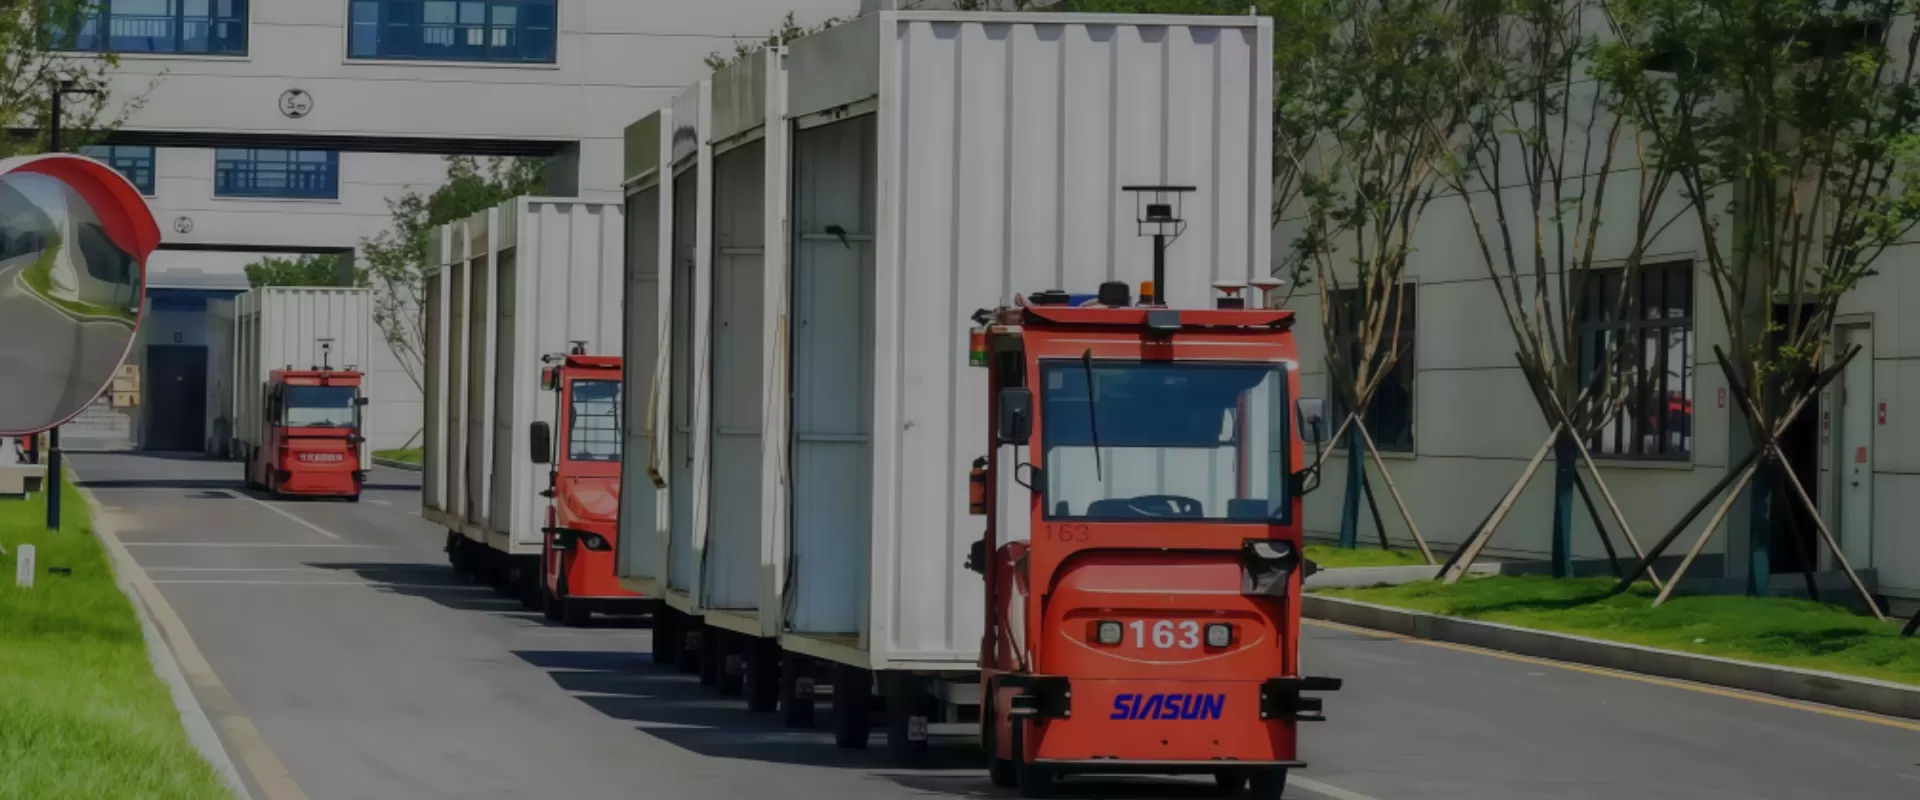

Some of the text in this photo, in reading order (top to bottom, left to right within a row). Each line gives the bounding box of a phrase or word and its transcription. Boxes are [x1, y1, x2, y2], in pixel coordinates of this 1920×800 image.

[1045, 524, 1090, 542] 163
[1129, 619, 1199, 649] 163
[1110, 693, 1226, 720] SIASUN
